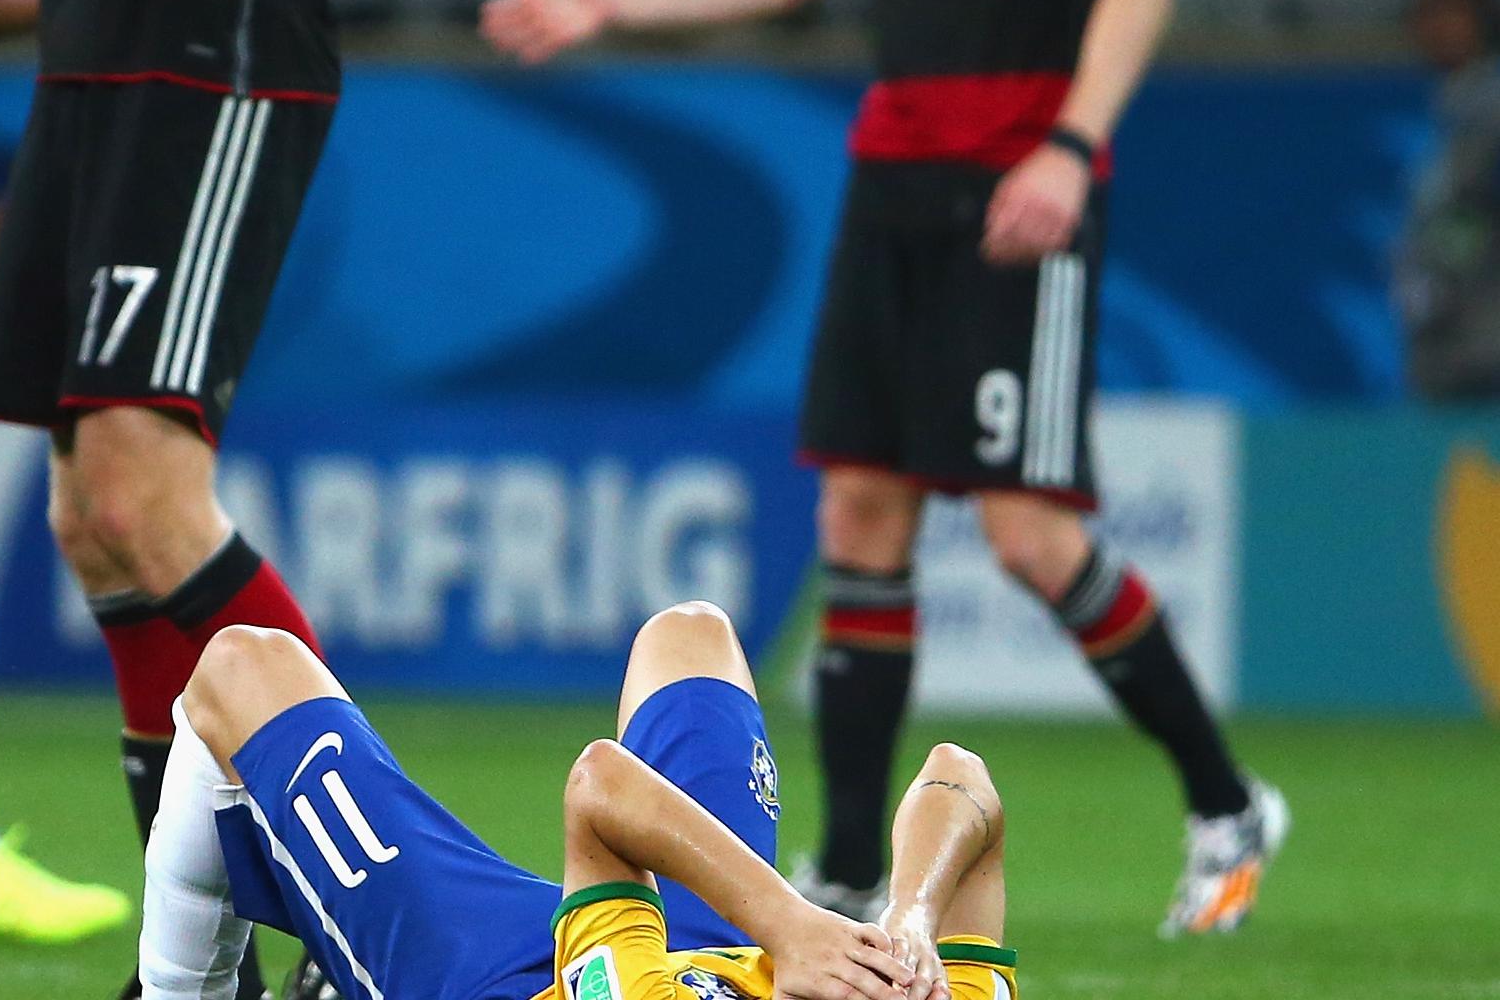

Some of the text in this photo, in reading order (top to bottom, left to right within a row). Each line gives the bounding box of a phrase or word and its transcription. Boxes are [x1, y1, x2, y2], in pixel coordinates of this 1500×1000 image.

[76, 263, 160, 367] 17
[974, 368, 1024, 462] 9
[292, 769, 400, 889] 11
